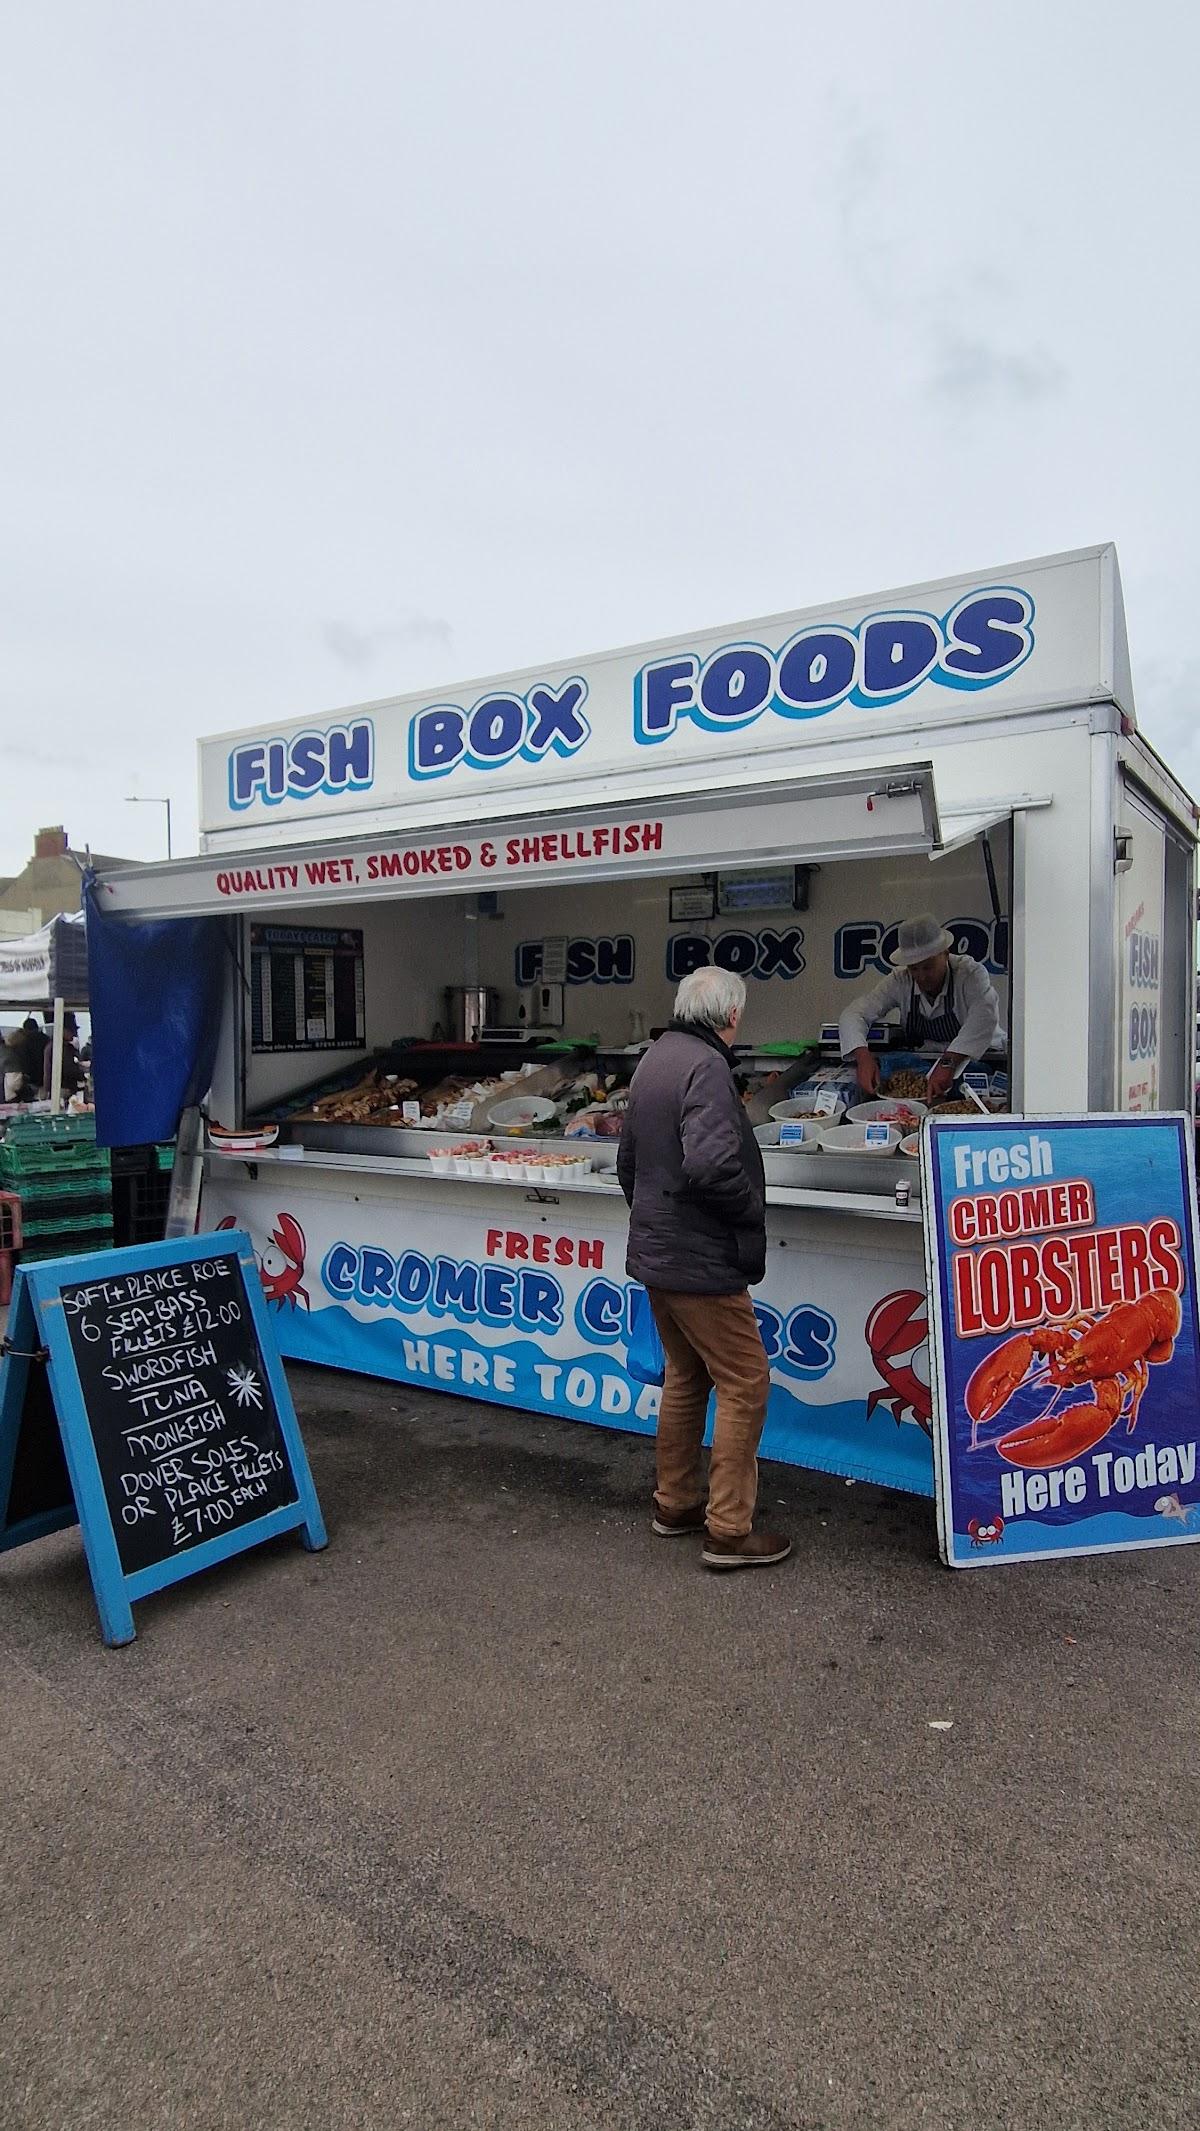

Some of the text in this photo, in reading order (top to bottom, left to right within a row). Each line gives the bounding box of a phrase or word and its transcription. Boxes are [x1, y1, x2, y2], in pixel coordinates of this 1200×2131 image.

[229, 585, 1036, 812] FISH BOX FOODS
[216, 822, 663, 895] QUALITY WET, SMOKED & SHELLFISH
[515, 934, 635, 987] FSH
[666, 926, 806, 982] BOX
[1129, 929, 1159, 989] FISH
[1129, 1002, 1158, 1061] BOX
[954, 1135, 1053, 1188] Fresh
[951, 1180, 1093, 1243] CROMER
[126, 1268, 189, 1297] PLAICE
[192, 1259, 231, 1282] ROE
[486, 1229, 605, 1270] FRESH
[954, 1219, 1184, 1335] LOBSTERS
[81, 1289, 207, 1342] 6 SEA-BASS
[321, 1241, 564, 1336] CROMER
[102, 1340, 218, 1391] SWORDFISH
[402, 1339, 664, 1420] HERE TODA
[128, 1380, 208, 1417] TUNA
[127, 1402, 226, 1457] MONKFISH
[120, 1435, 259, 1496] DOVER SOLES
[230, 1479, 268, 1506] EACH
[1001, 1442, 1196, 1518] Here Today
[121, 1495, 157, 1525] OR
[164, 1471, 229, 1512] PLAICE
